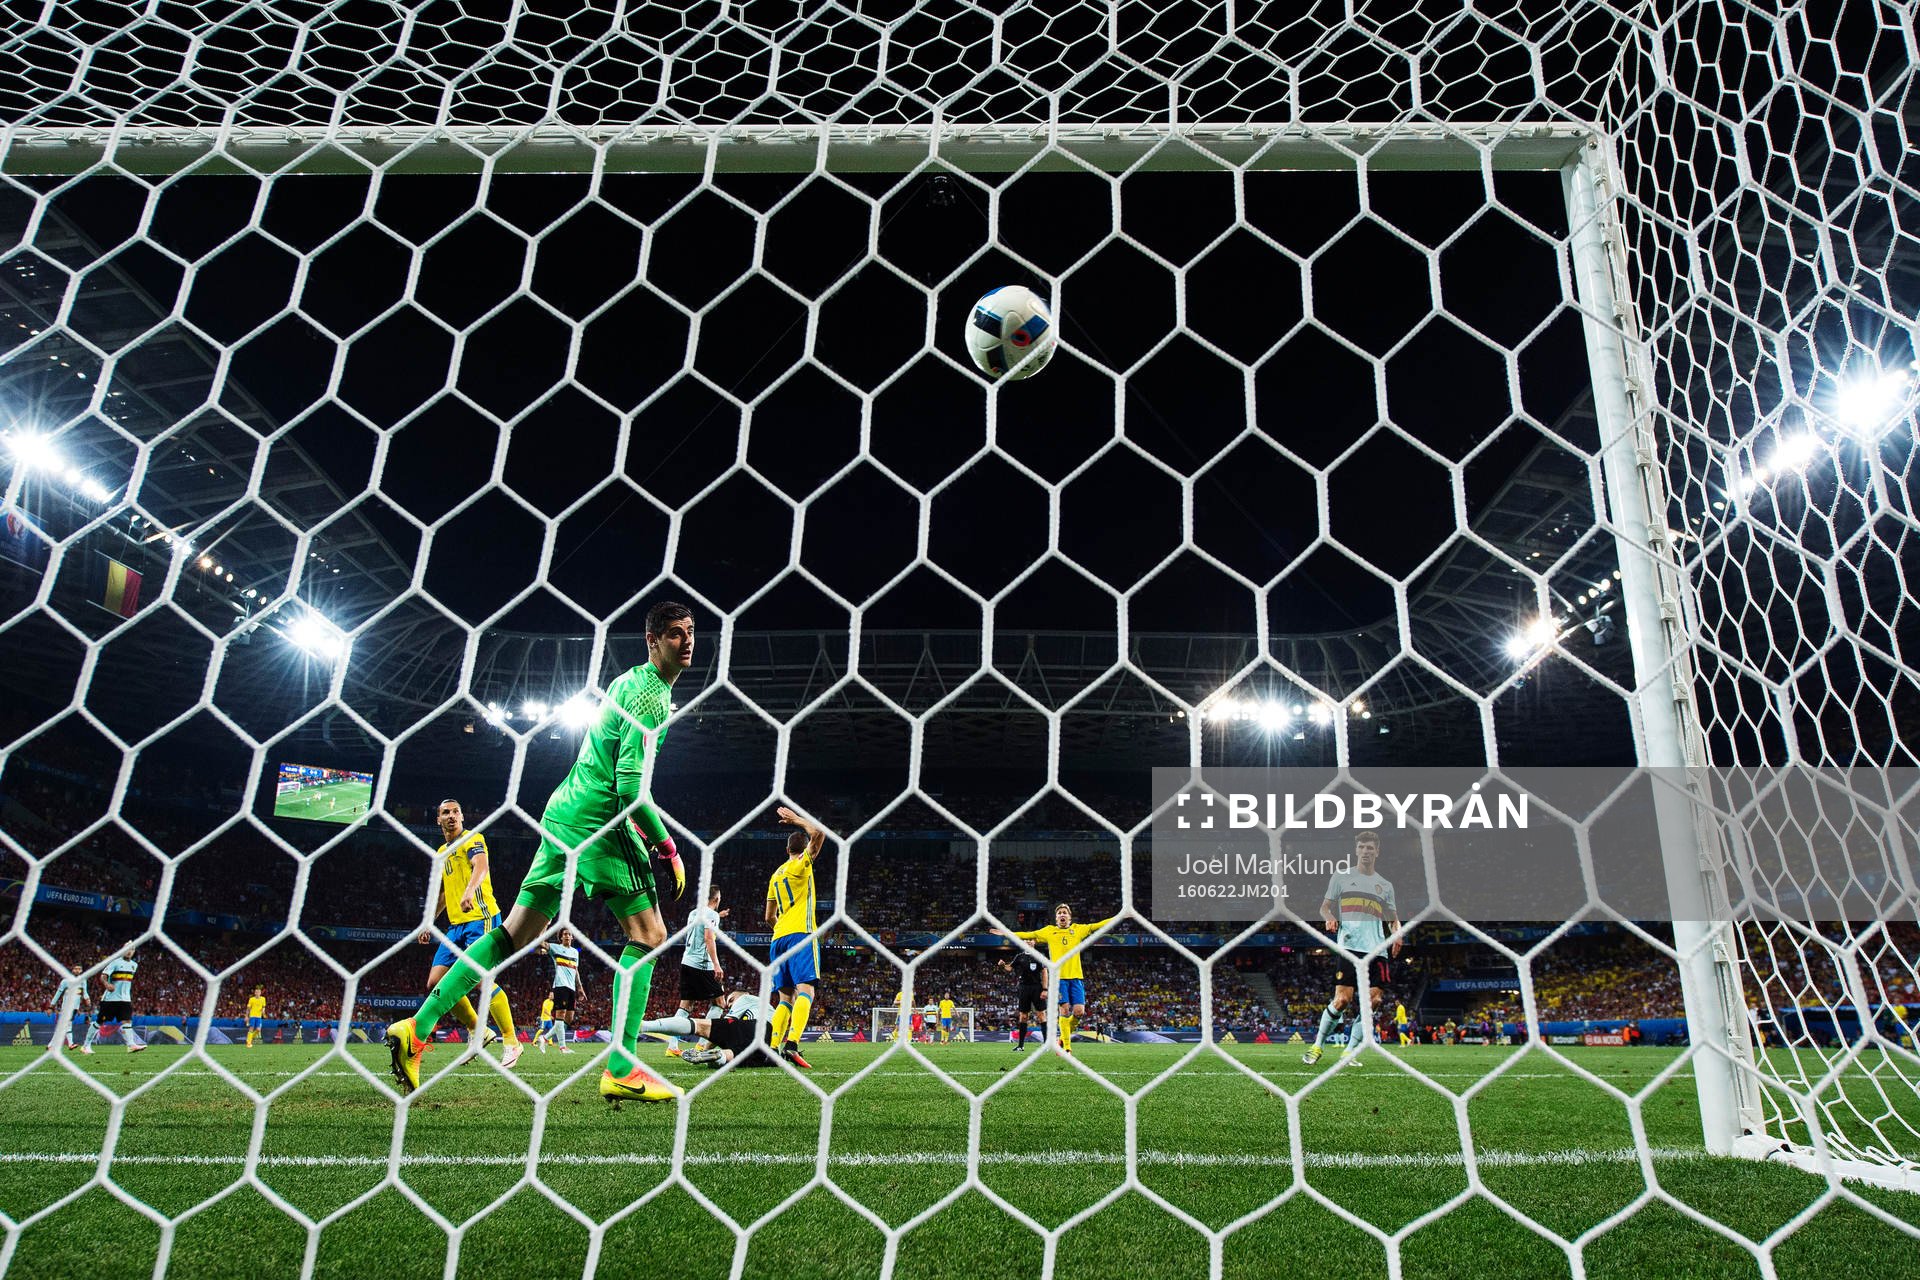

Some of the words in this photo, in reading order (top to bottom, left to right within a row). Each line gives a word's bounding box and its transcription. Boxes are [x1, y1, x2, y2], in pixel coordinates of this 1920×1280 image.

[46, 890, 62, 900] UEFA
[63, 893, 79, 902] EURO
[774, 877, 795, 914] 11
[347, 930, 366, 939] UEFA
[367, 931, 385, 939] EURO
[1062, 935, 1068, 945] 6
[1478, 981, 1499, 989] EURO
[374, 999, 396, 1007] EURO
[397, 999, 417, 1007] 2016
